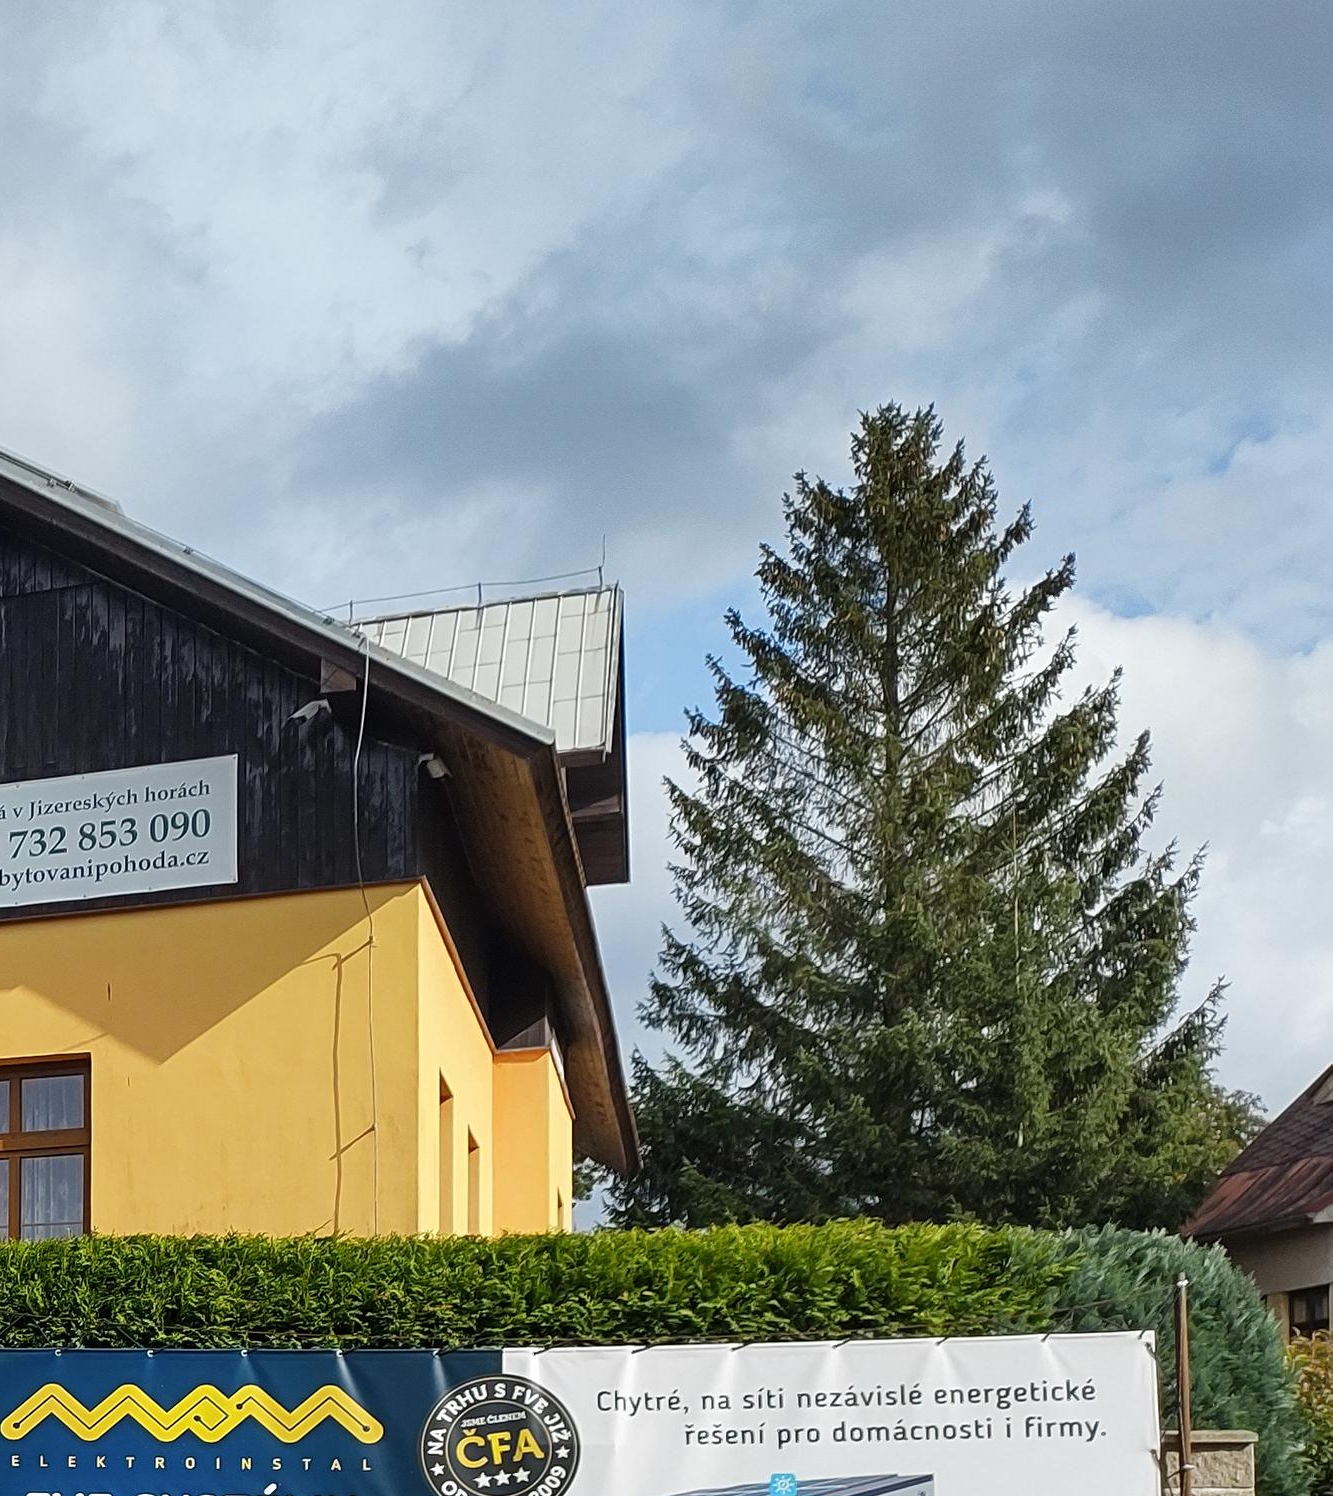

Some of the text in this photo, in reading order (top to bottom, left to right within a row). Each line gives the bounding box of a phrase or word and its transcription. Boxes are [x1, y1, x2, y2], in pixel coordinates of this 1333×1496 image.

[13, 806, 23, 818] v
[28, 788, 139, 822] Jizereských
[144, 780, 211, 802] horách
[8, 826, 68, 860] 732
[78, 817, 139, 852] 853
[149, 808, 212, 844] 090
[597, 1380, 1097, 1416] Chytré, na síti nezávislé energetické
[427, 1383, 572, 1455] NA TRHU S FVE JIŽ
[684, 1416, 1107, 1449] řešení pro domácnosti i firmy.
[11, 1455, 371, 1471] ELEKTROINSTAL
[456, 1428, 545, 1469] ČFA
